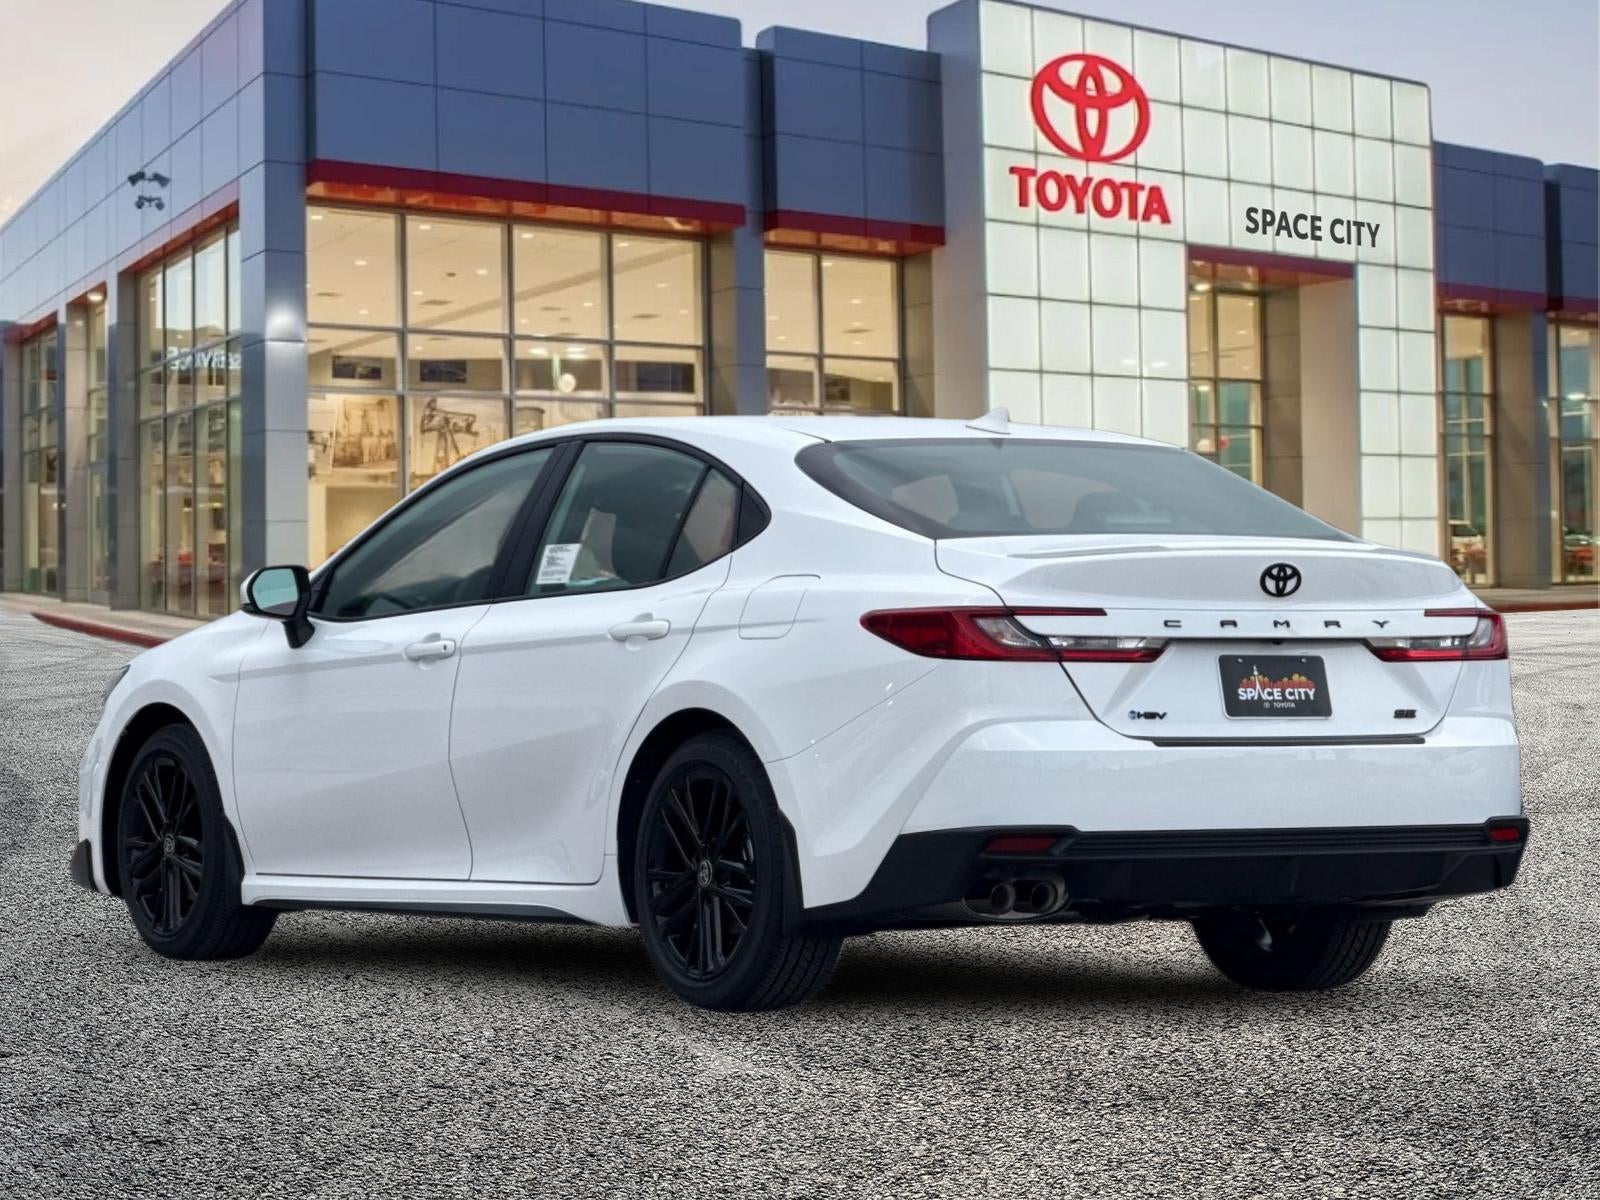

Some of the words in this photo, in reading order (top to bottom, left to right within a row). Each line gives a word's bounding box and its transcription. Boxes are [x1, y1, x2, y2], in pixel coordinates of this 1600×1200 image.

[1009, 166, 1171, 225] TOYOTA
[1245, 206, 1322, 242] SPACE
[1329, 217, 1381, 248] CITY
[1163, 619, 1390, 629] CAMRY
[1237, 687, 1282, 701] SPACE
[1285, 687, 1316, 701] CITY
[1136, 710, 1168, 721] HEV
